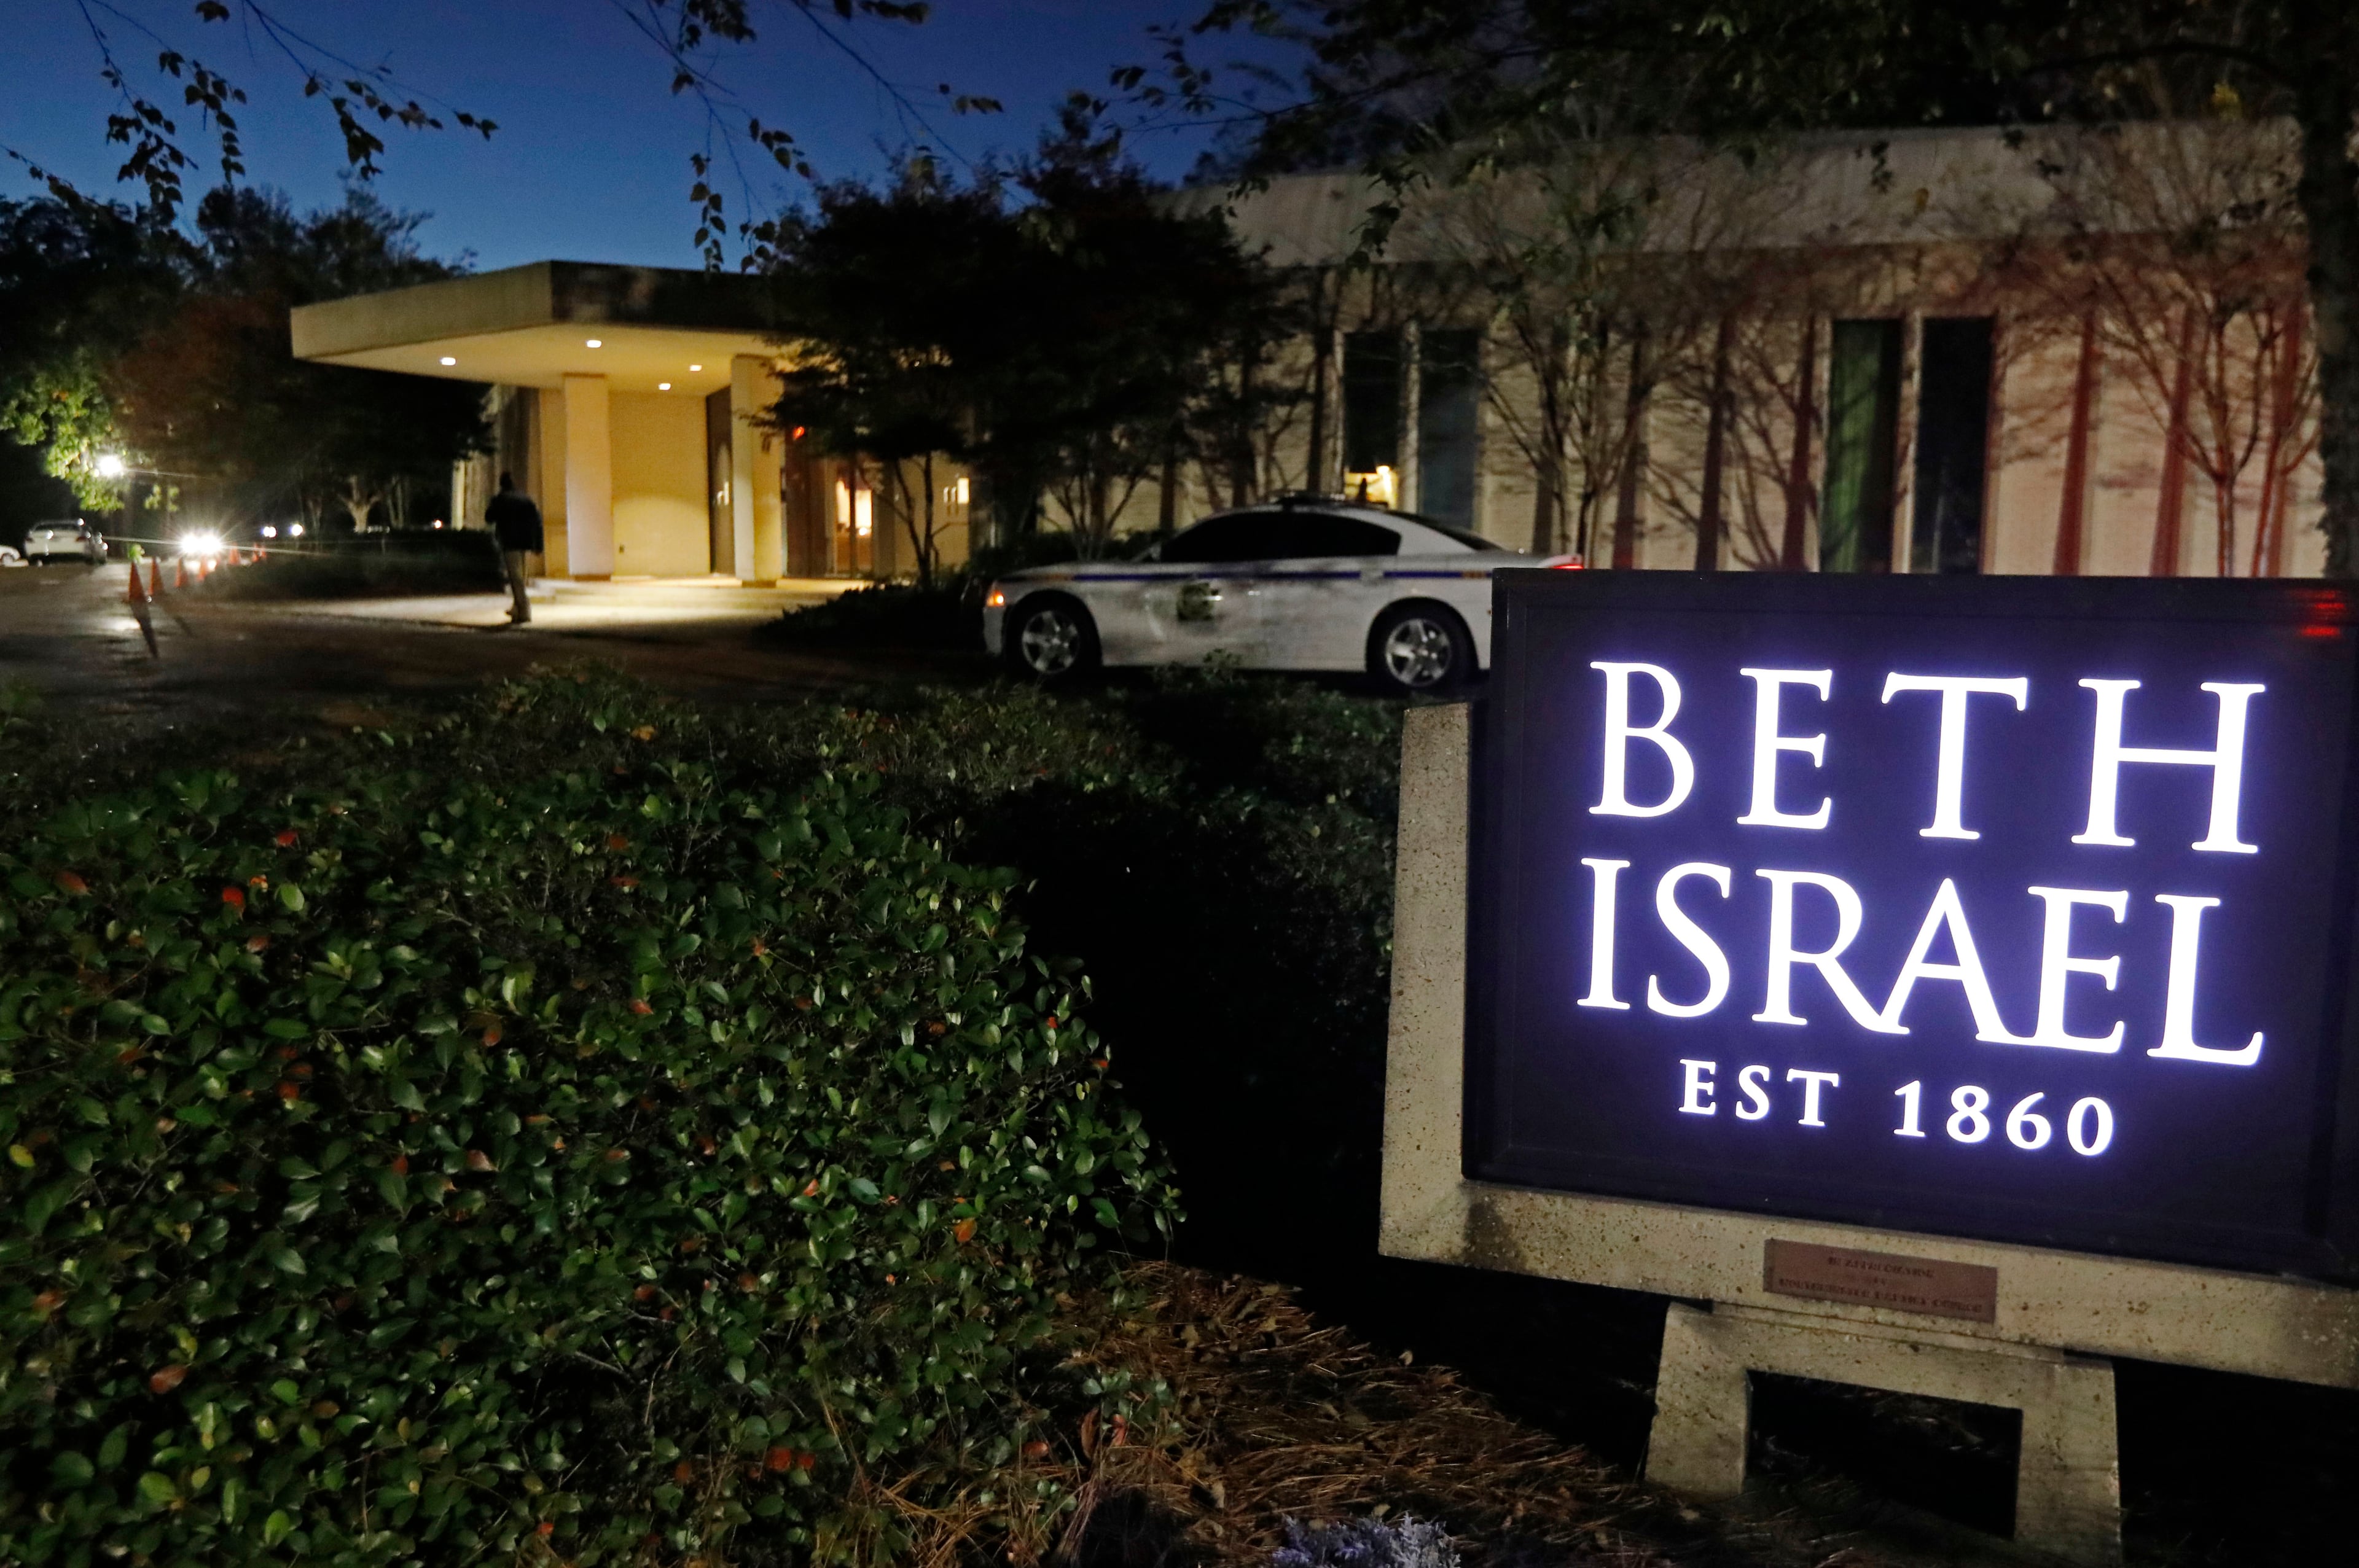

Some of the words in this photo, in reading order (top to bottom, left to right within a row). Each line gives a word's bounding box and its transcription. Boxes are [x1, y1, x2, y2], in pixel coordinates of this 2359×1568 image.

[1589, 661, 2266, 854] BETH
[1577, 857, 2264, 1067] ISRAEL
[1678, 1058, 1840, 1126] EST
[1893, 1080, 2114, 1156] 1860
